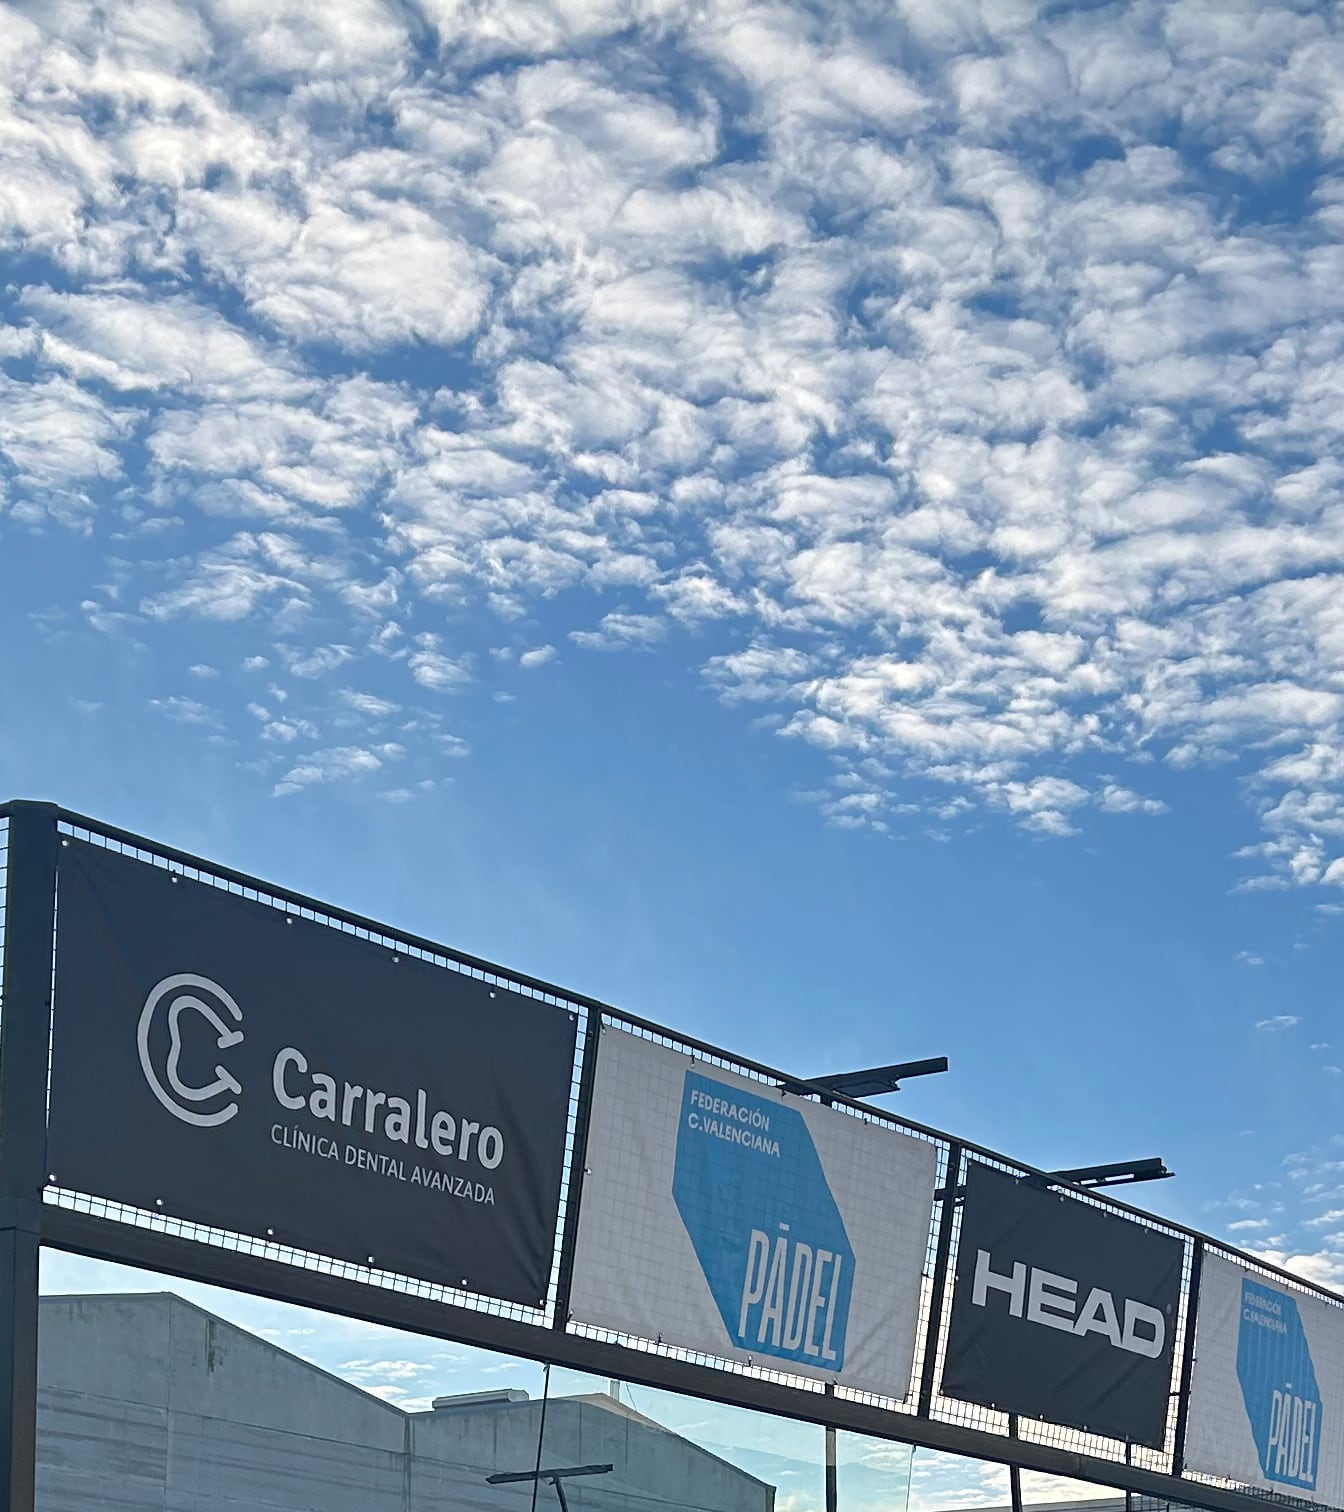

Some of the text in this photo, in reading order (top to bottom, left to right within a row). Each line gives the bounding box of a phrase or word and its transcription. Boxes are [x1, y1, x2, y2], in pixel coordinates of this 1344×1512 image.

[272, 1047, 504, 1170] Carralero
[690, 1090, 770, 1131] FEDERACIÓN
[271, 1124, 495, 1206] CLÍNICA DENTAL AVANZADA
[972, 1248, 1166, 1360] HEAD
